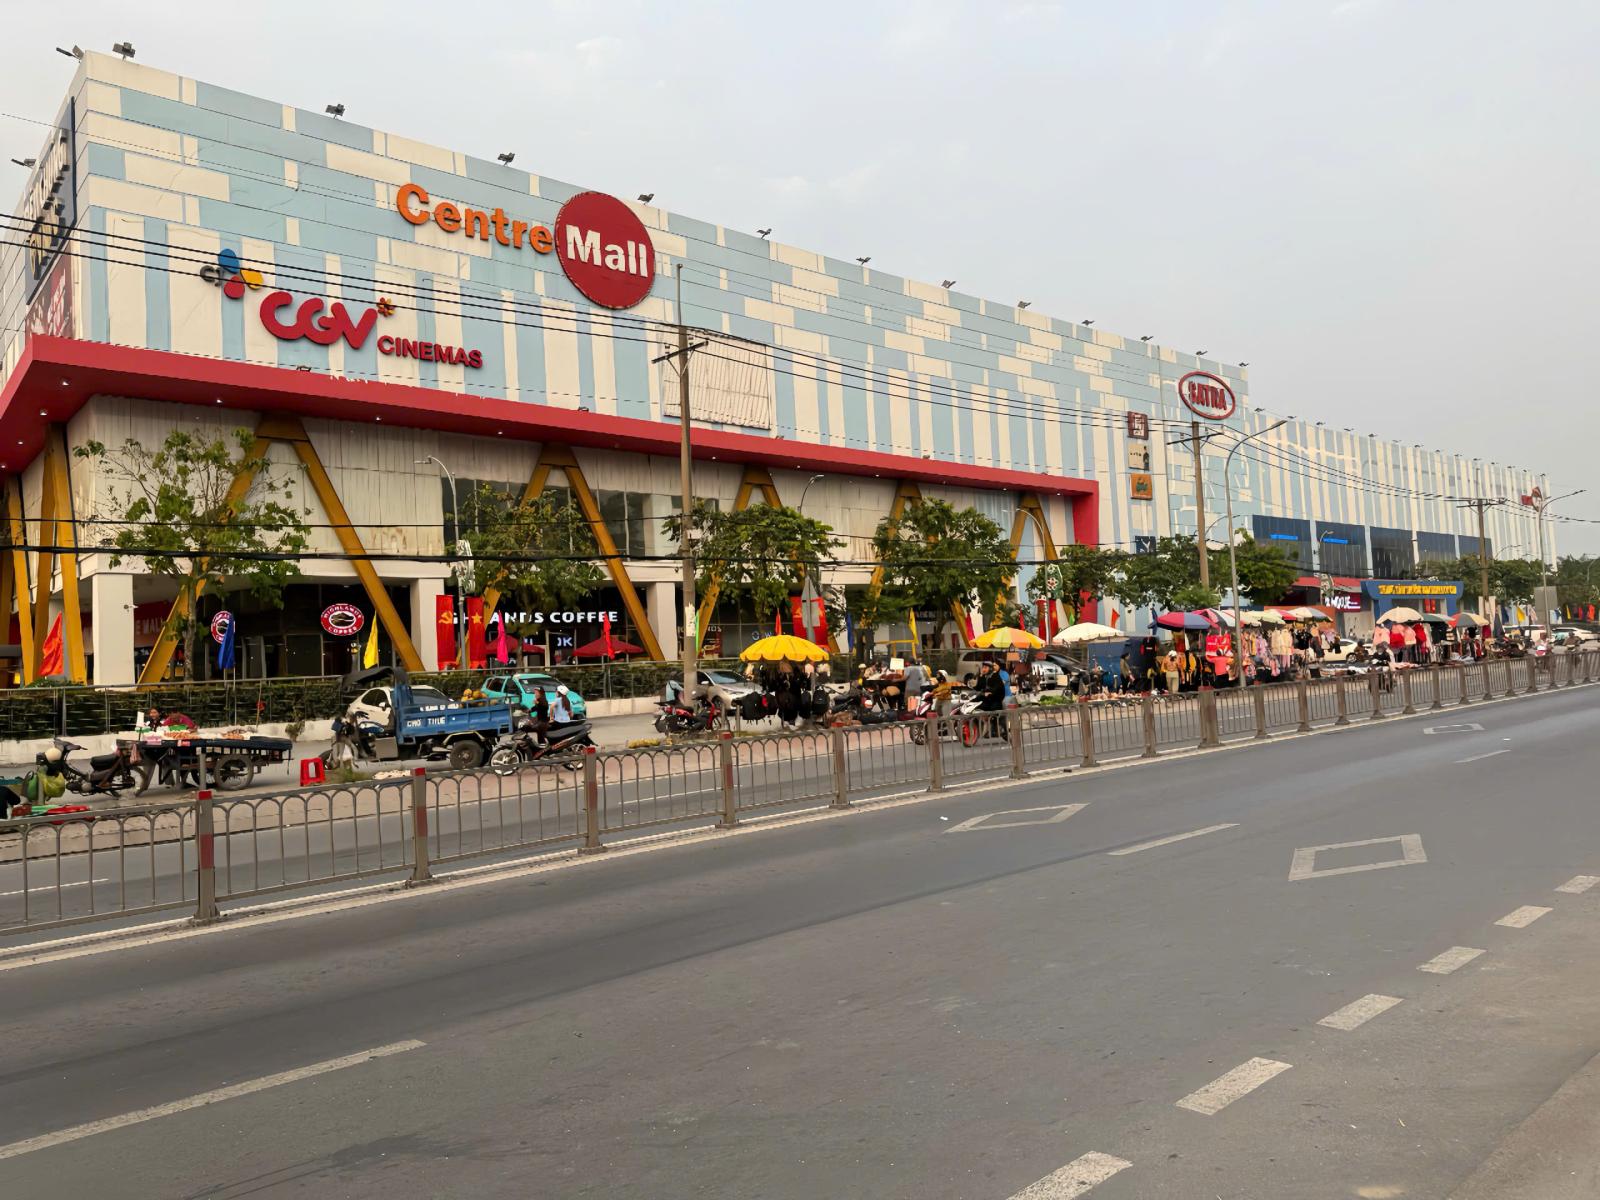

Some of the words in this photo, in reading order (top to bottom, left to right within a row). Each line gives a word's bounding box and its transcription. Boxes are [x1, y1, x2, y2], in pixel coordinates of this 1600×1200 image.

[396, 183, 553, 255] Centre
[565, 224, 649, 278] Mall
[260, 290, 378, 350] CGV
[377, 334, 483, 369] CINEMAS
[550, 611, 619, 624] COFFEE
